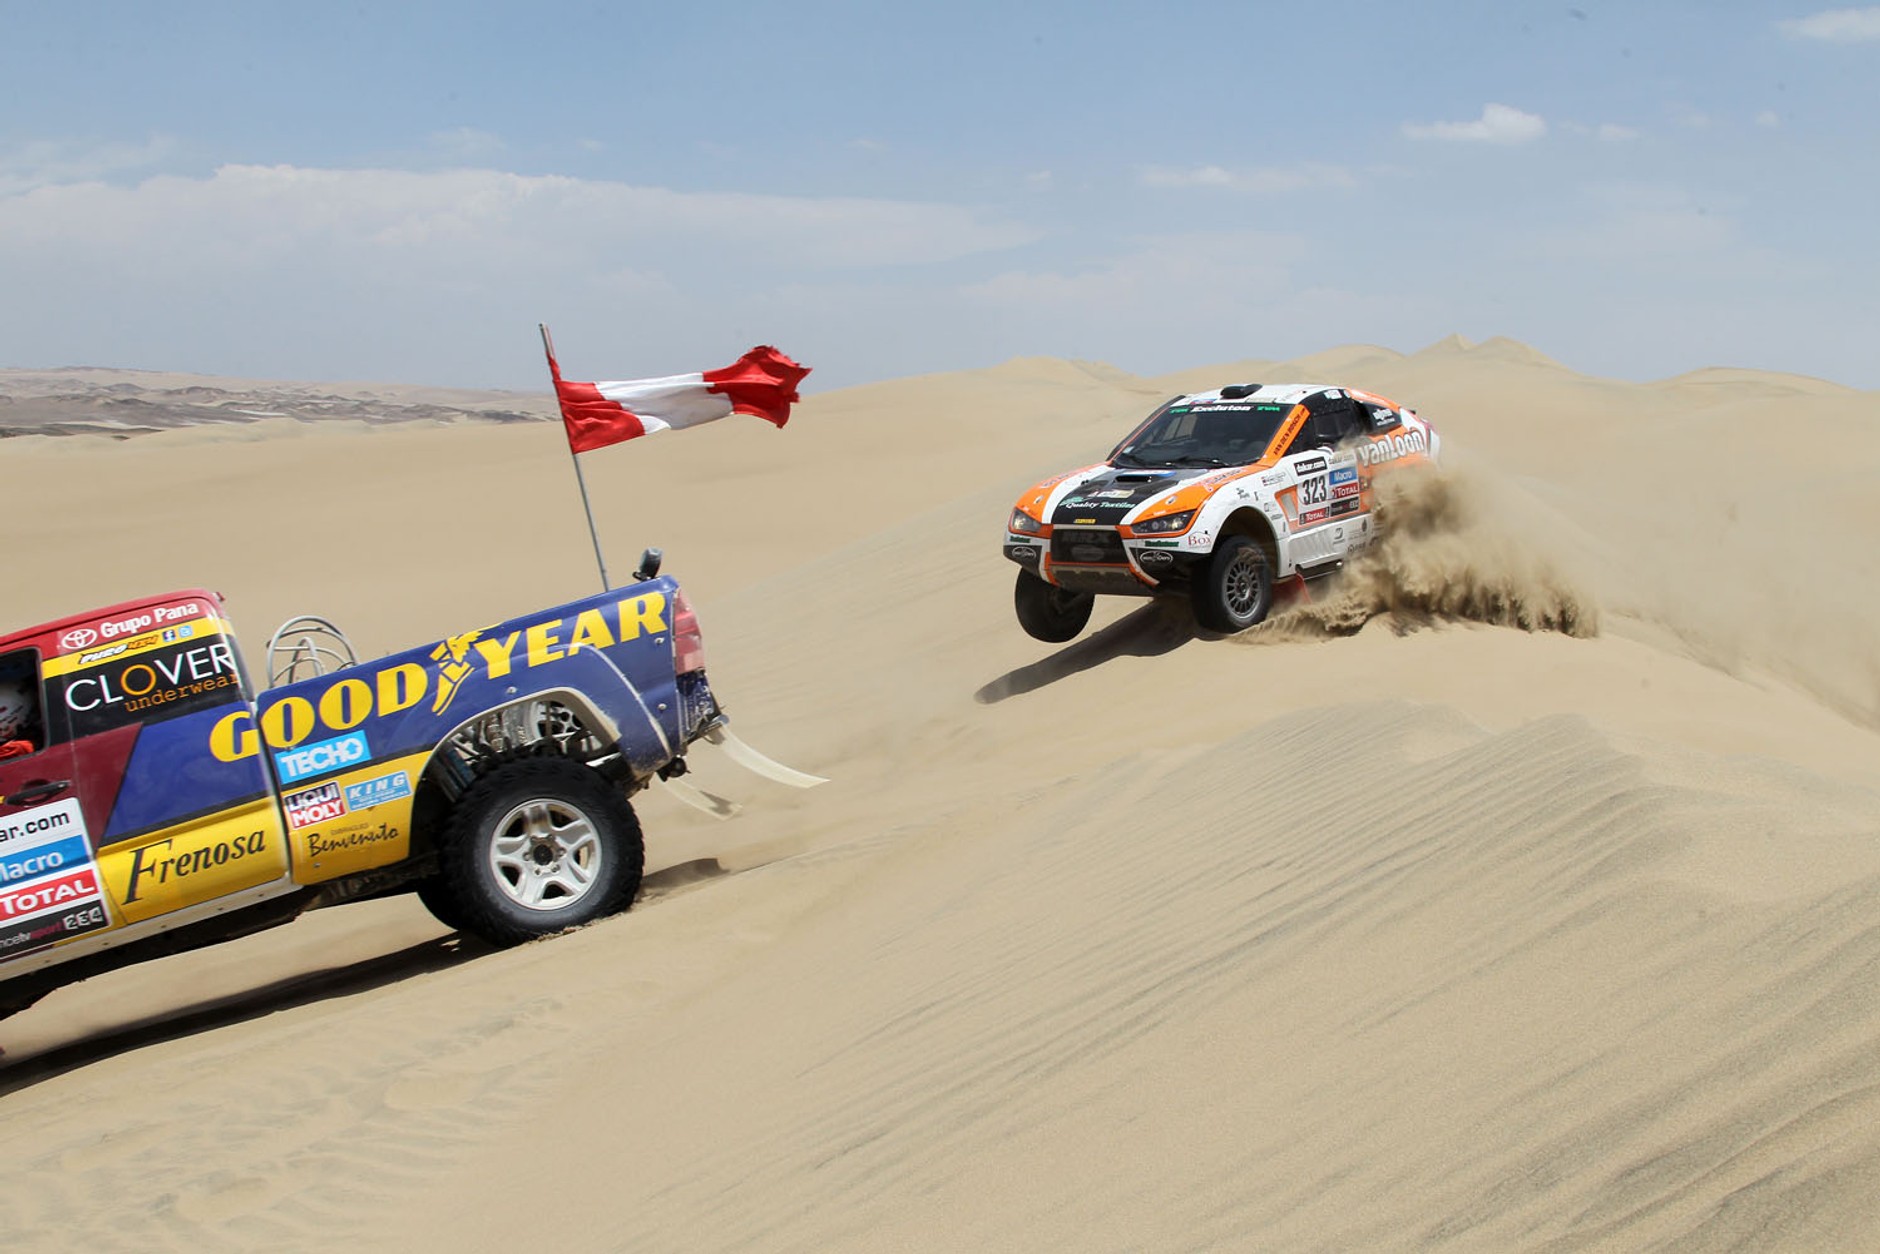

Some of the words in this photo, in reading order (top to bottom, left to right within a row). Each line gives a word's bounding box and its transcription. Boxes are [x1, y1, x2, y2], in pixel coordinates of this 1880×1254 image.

[1302, 475, 1327, 505] 323
[1334, 470, 1353, 481] Macro
[1336, 485, 1358, 496] TOTAL
[99, 613, 152, 638] Grupo
[153, 602, 199, 623] Pana
[64, 643, 237, 712] CLOVER
[123, 673, 239, 713] underwear
[285, 783, 339, 811] LIQUI
[350, 773, 406, 800] KING
[291, 802, 346, 828] MOLY
[307, 822, 400, 858] Benvenuto
[122, 828, 266, 906] Frenosa
[0, 879, 96, 916] TOTAL
